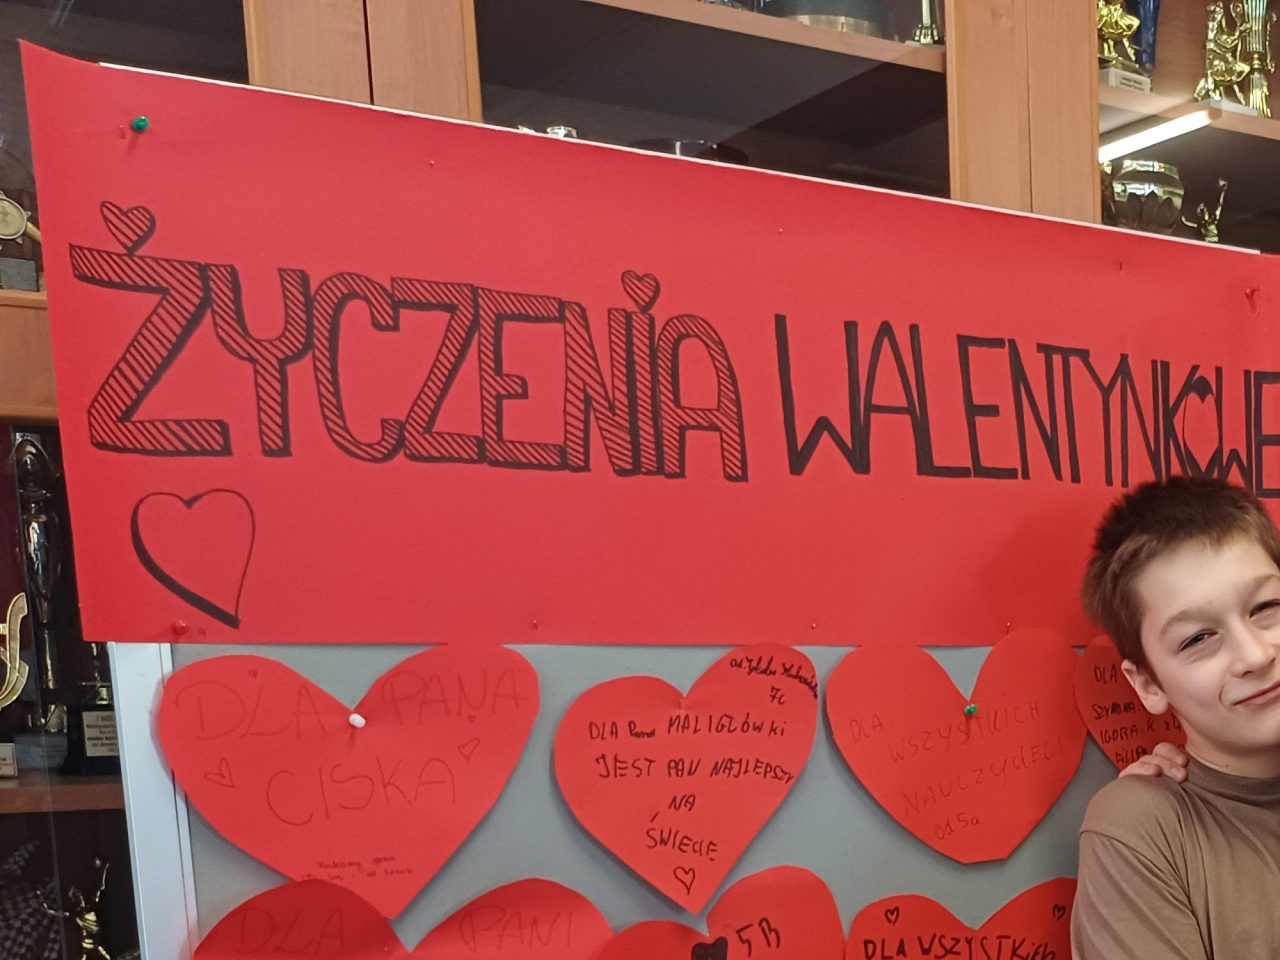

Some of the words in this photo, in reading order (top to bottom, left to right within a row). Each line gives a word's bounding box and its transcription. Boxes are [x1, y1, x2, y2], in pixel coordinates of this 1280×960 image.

[1094, 664, 1117, 684] DLA
[381, 668, 530, 726] PANA
[588, 720, 618, 741] DLA
[849, 712, 884, 744] DLA
[595, 753, 656, 779] JEST
[667, 758, 703, 778] PAN
[668, 794, 697, 812] NA
[864, 938, 907, 960] DLA
